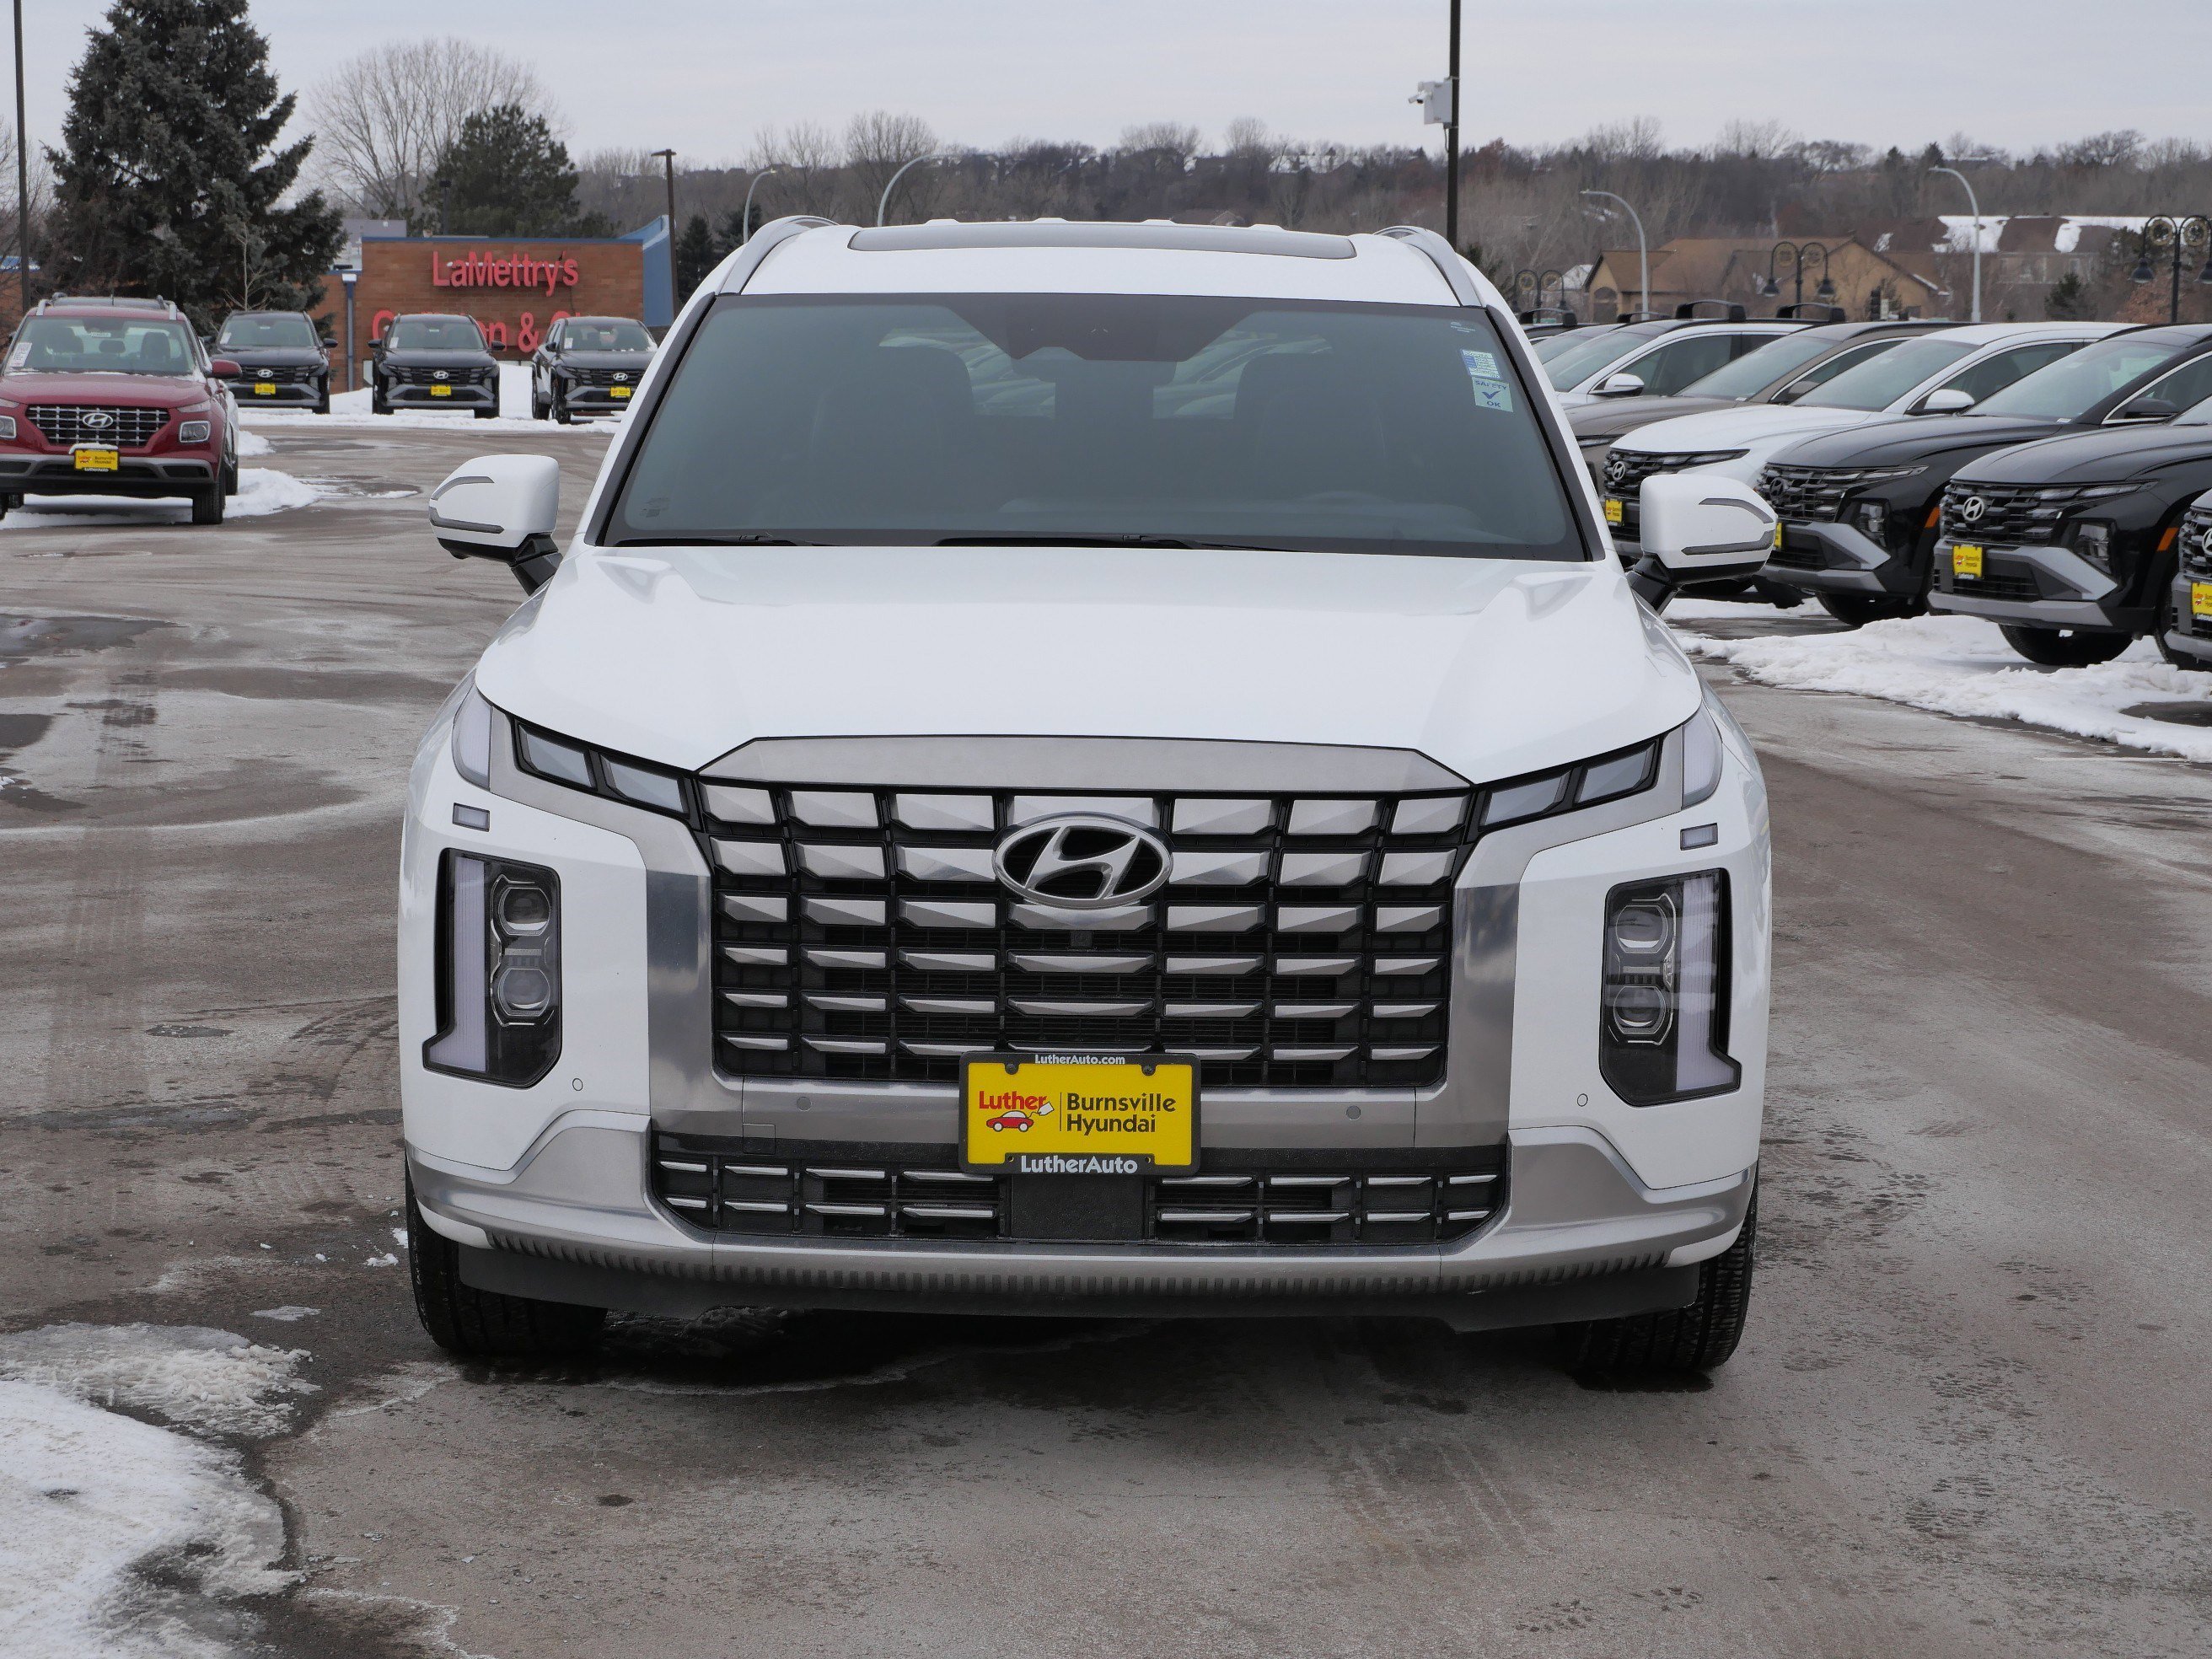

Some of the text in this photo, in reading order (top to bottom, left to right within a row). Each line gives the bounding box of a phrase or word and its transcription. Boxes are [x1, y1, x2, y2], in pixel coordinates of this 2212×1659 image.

[432, 250, 579, 297] LaMettry's
[518, 311, 540, 353] &
[1034, 1054, 1125, 1066] LutherAuto.com
[979, 1090, 1047, 1110] Luther
[1066, 1093, 1176, 1112] Burnsville
[1066, 1114, 1156, 1136] Hyundai
[1021, 1155, 1138, 1174] LutherAuto
